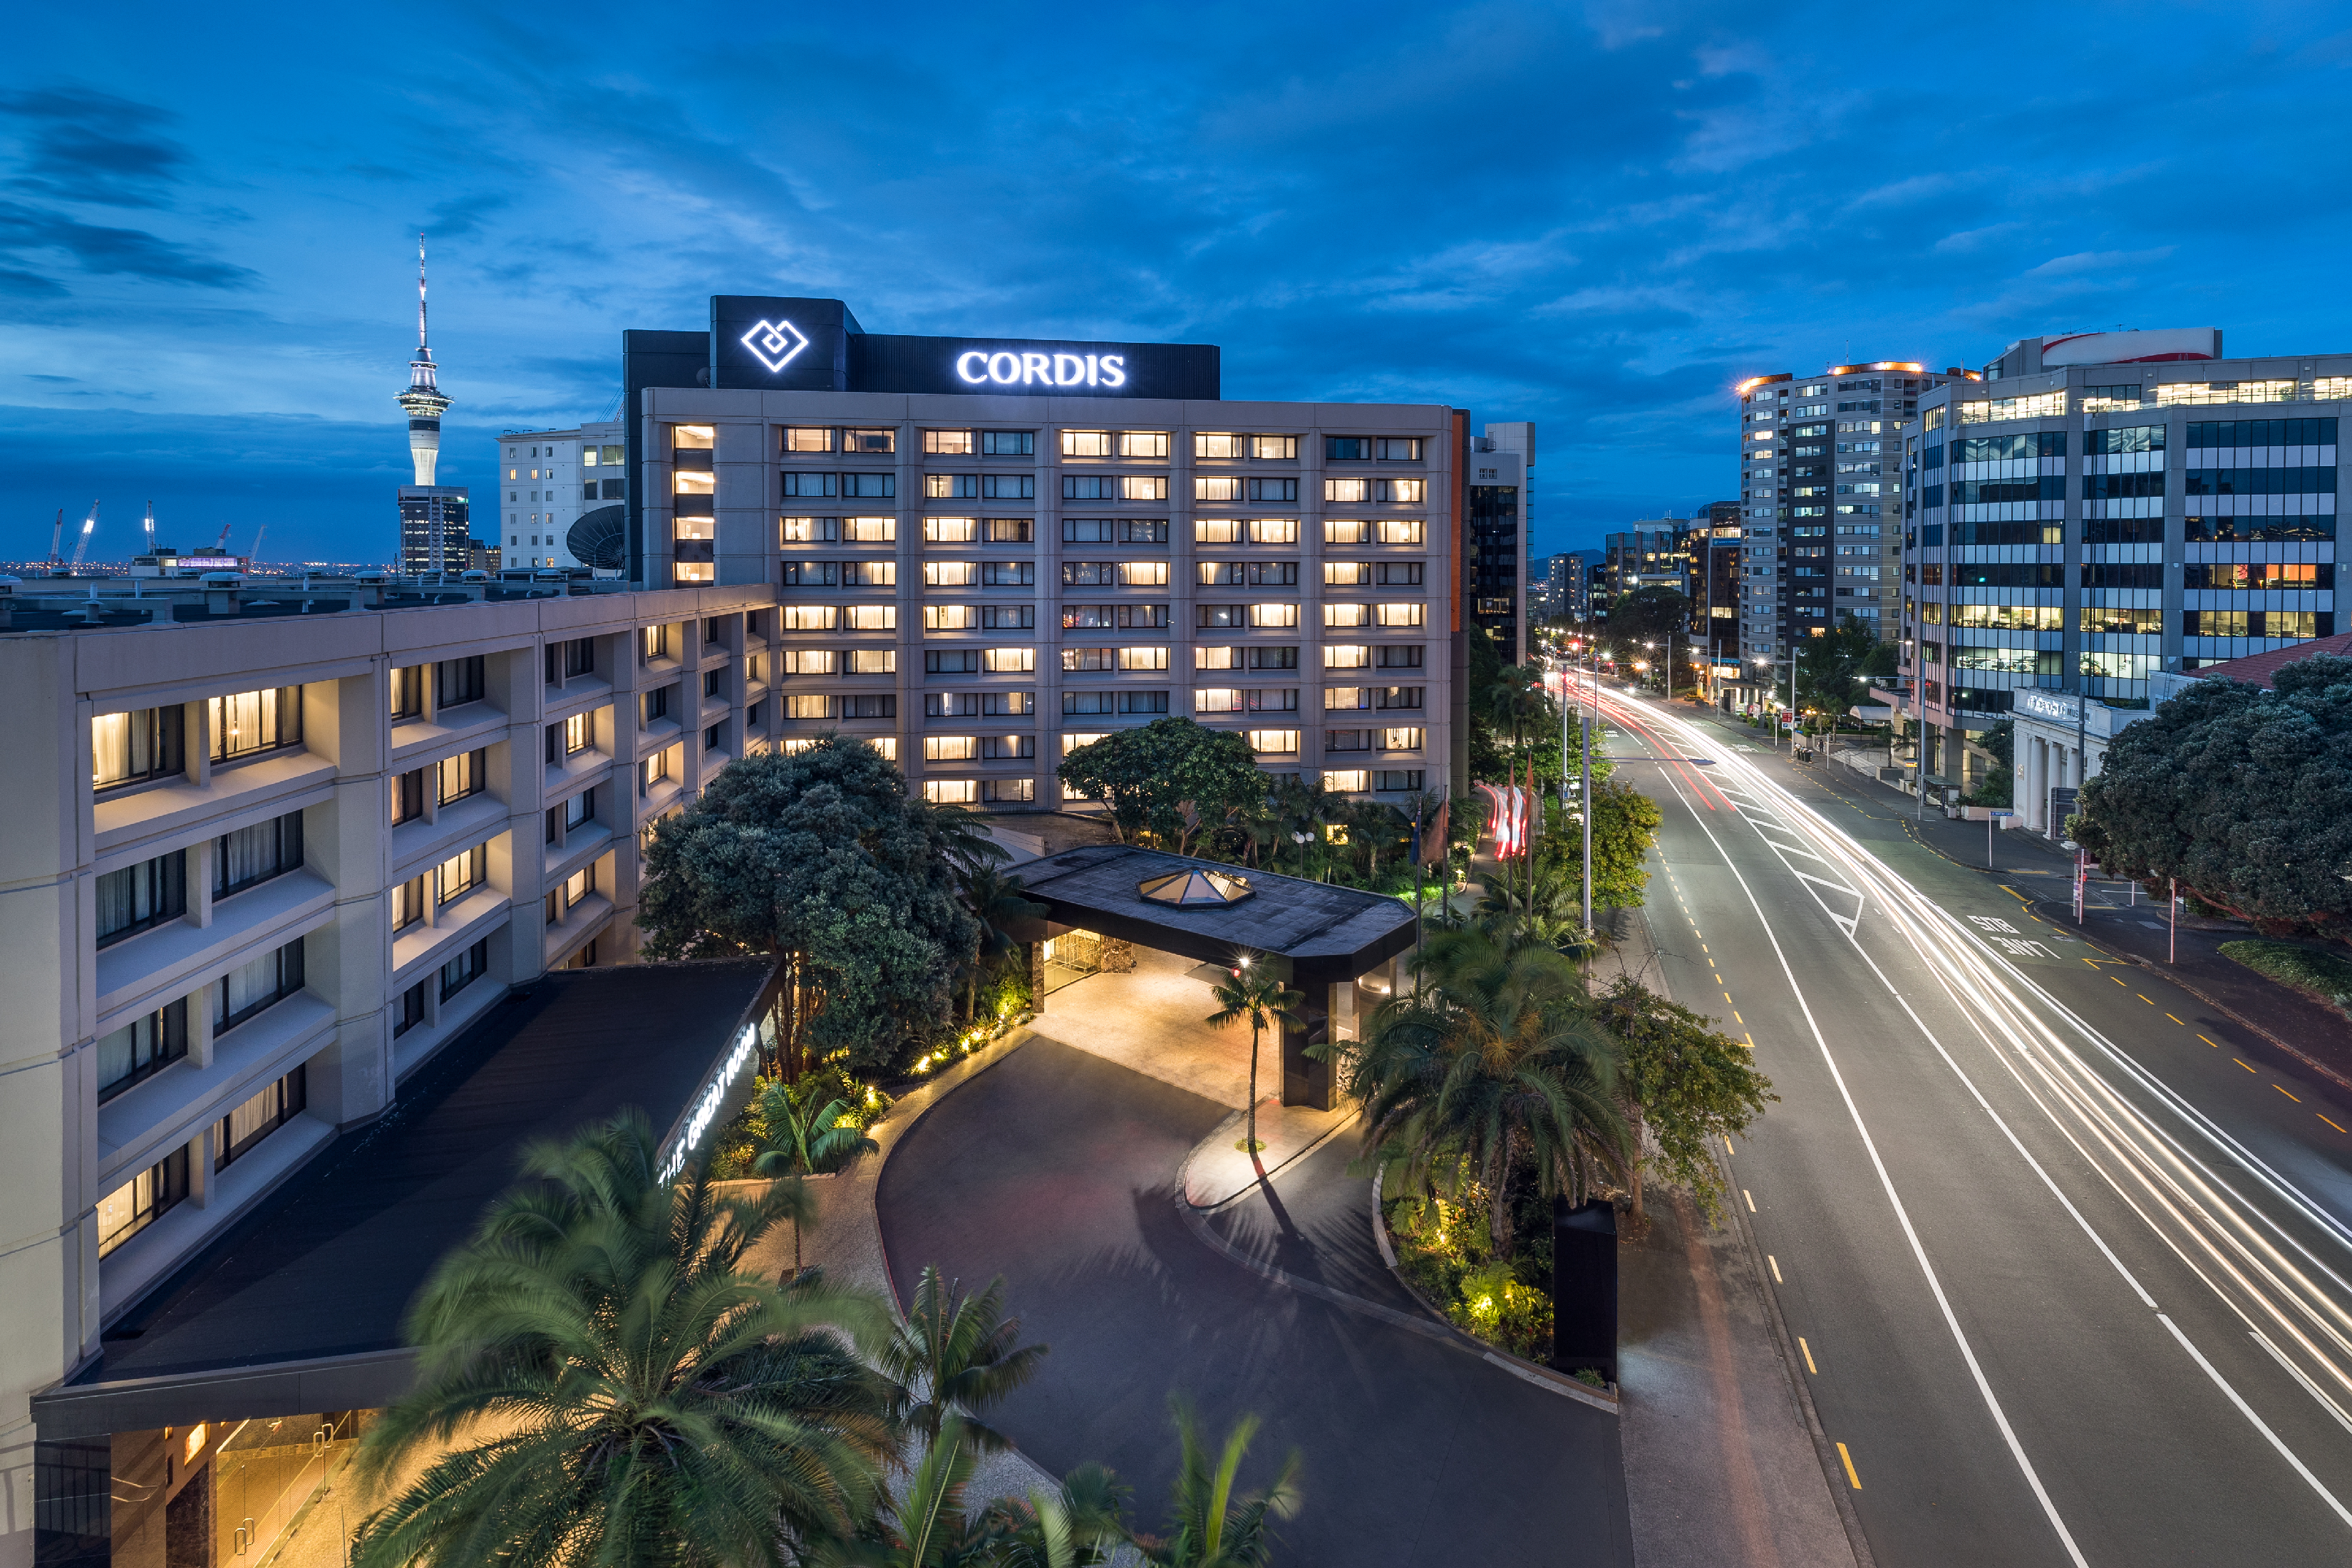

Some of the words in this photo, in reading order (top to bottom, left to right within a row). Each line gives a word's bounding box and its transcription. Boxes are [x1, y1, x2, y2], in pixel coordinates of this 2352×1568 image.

[956, 351, 1125, 386] CORDIS
[2067, 708, 2090, 721] MUSM
[1966, 915, 2021, 934] BUS
[1989, 936, 2062, 959] LANE
[657, 1138, 686, 1192] THE
[688, 1071, 726, 1150] GREAT
[726, 1022, 755, 1087] ROOM
